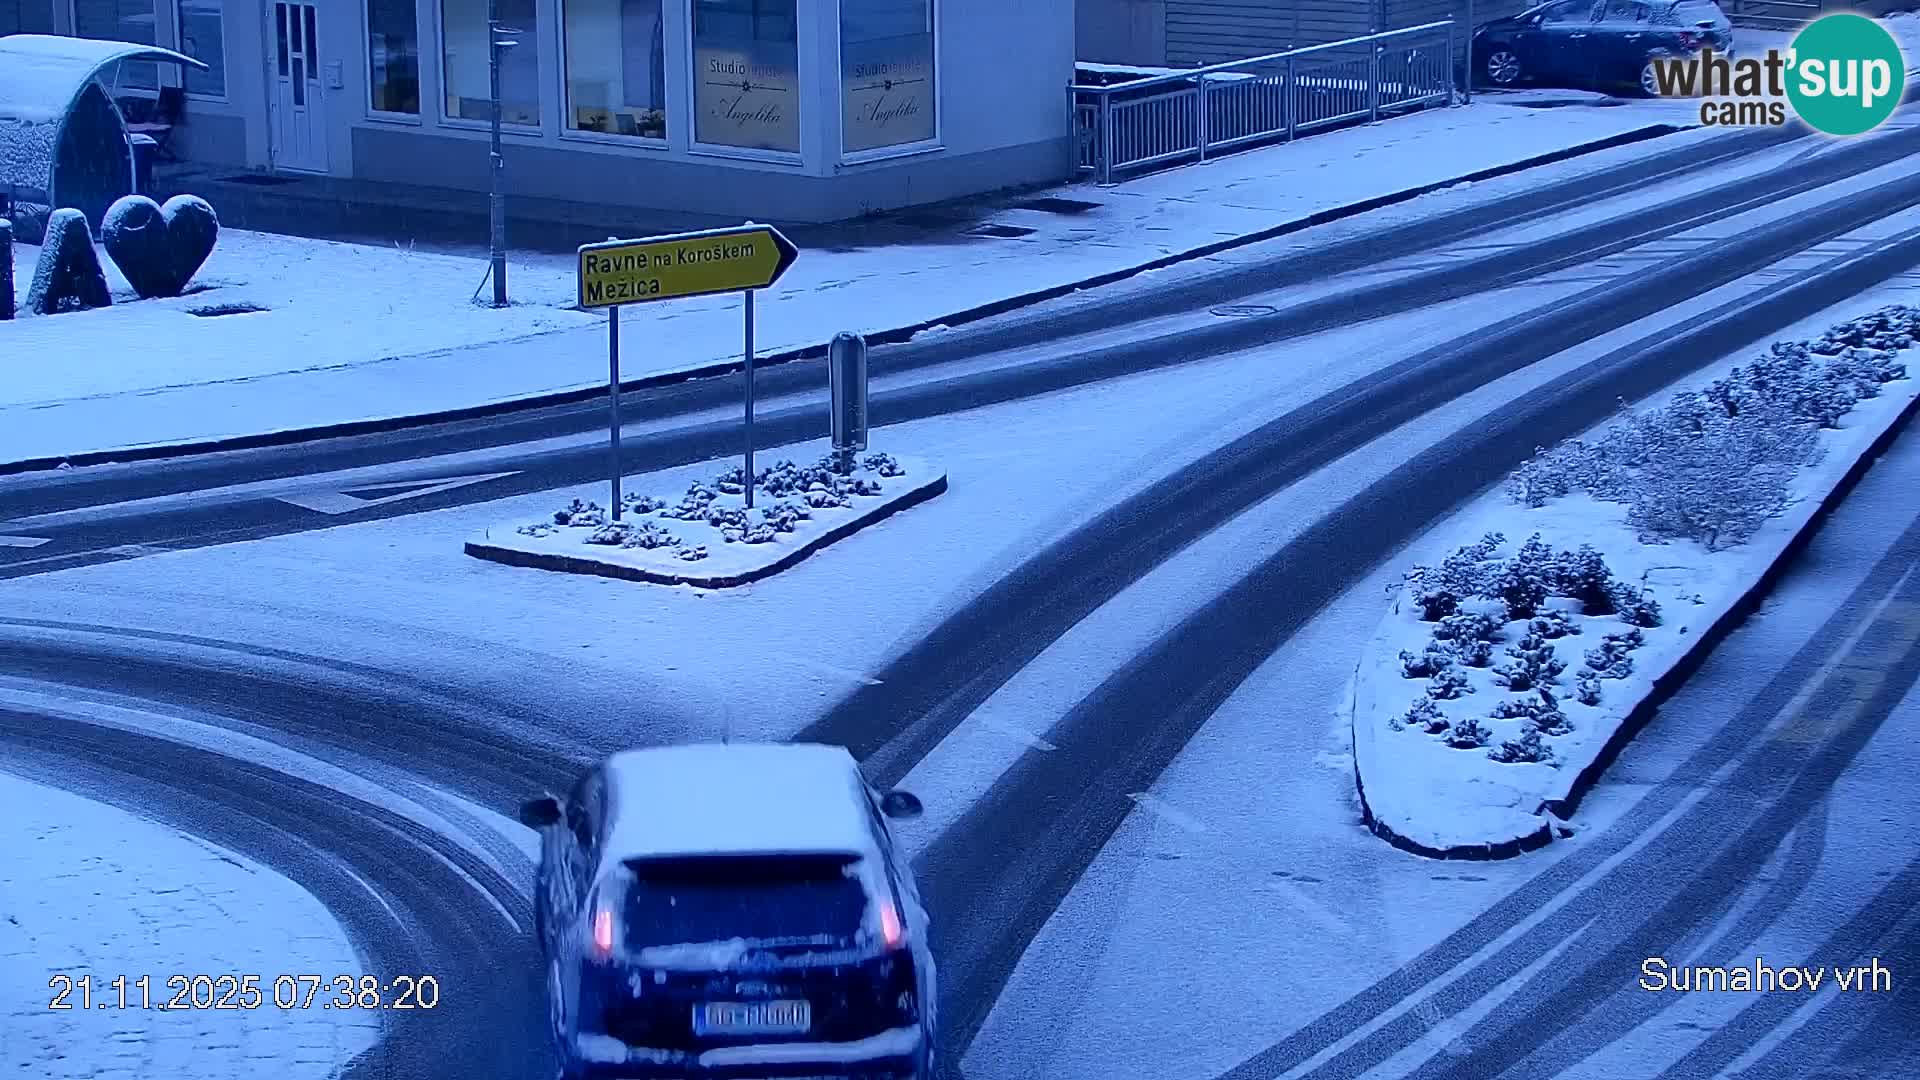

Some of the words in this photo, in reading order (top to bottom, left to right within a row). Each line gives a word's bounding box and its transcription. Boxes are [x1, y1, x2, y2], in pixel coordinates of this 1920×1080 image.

[709, 58, 746, 75] Studio
[855, 62, 888, 79] Studio
[711, 95, 783, 128] Angelika
[856, 95, 920, 128] Angelika
[587, 253, 647, 275] Ravne
[653, 253, 671, 267] na
[677, 242, 754, 265] Koroškem
[587, 278, 660, 302] Mežica
